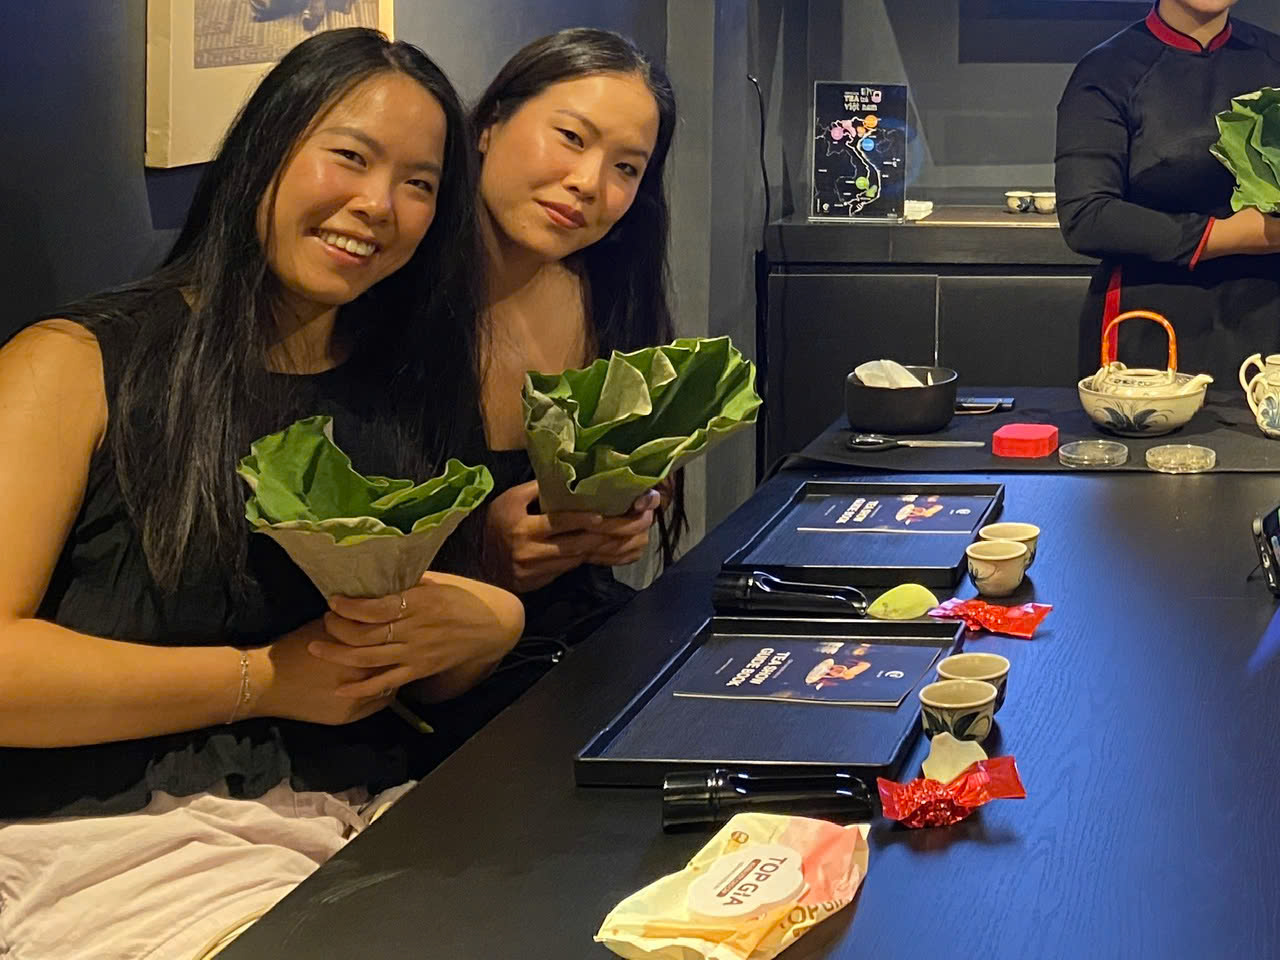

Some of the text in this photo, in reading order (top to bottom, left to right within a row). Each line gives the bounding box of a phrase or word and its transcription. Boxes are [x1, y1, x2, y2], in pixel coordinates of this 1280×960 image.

[746, 647, 775, 669] GUIDE
[768, 651, 791, 665] TEA
[726, 668, 755, 687] BOOK
[749, 665, 777, 685] SHOW
[754, 857, 788, 882] TOP
